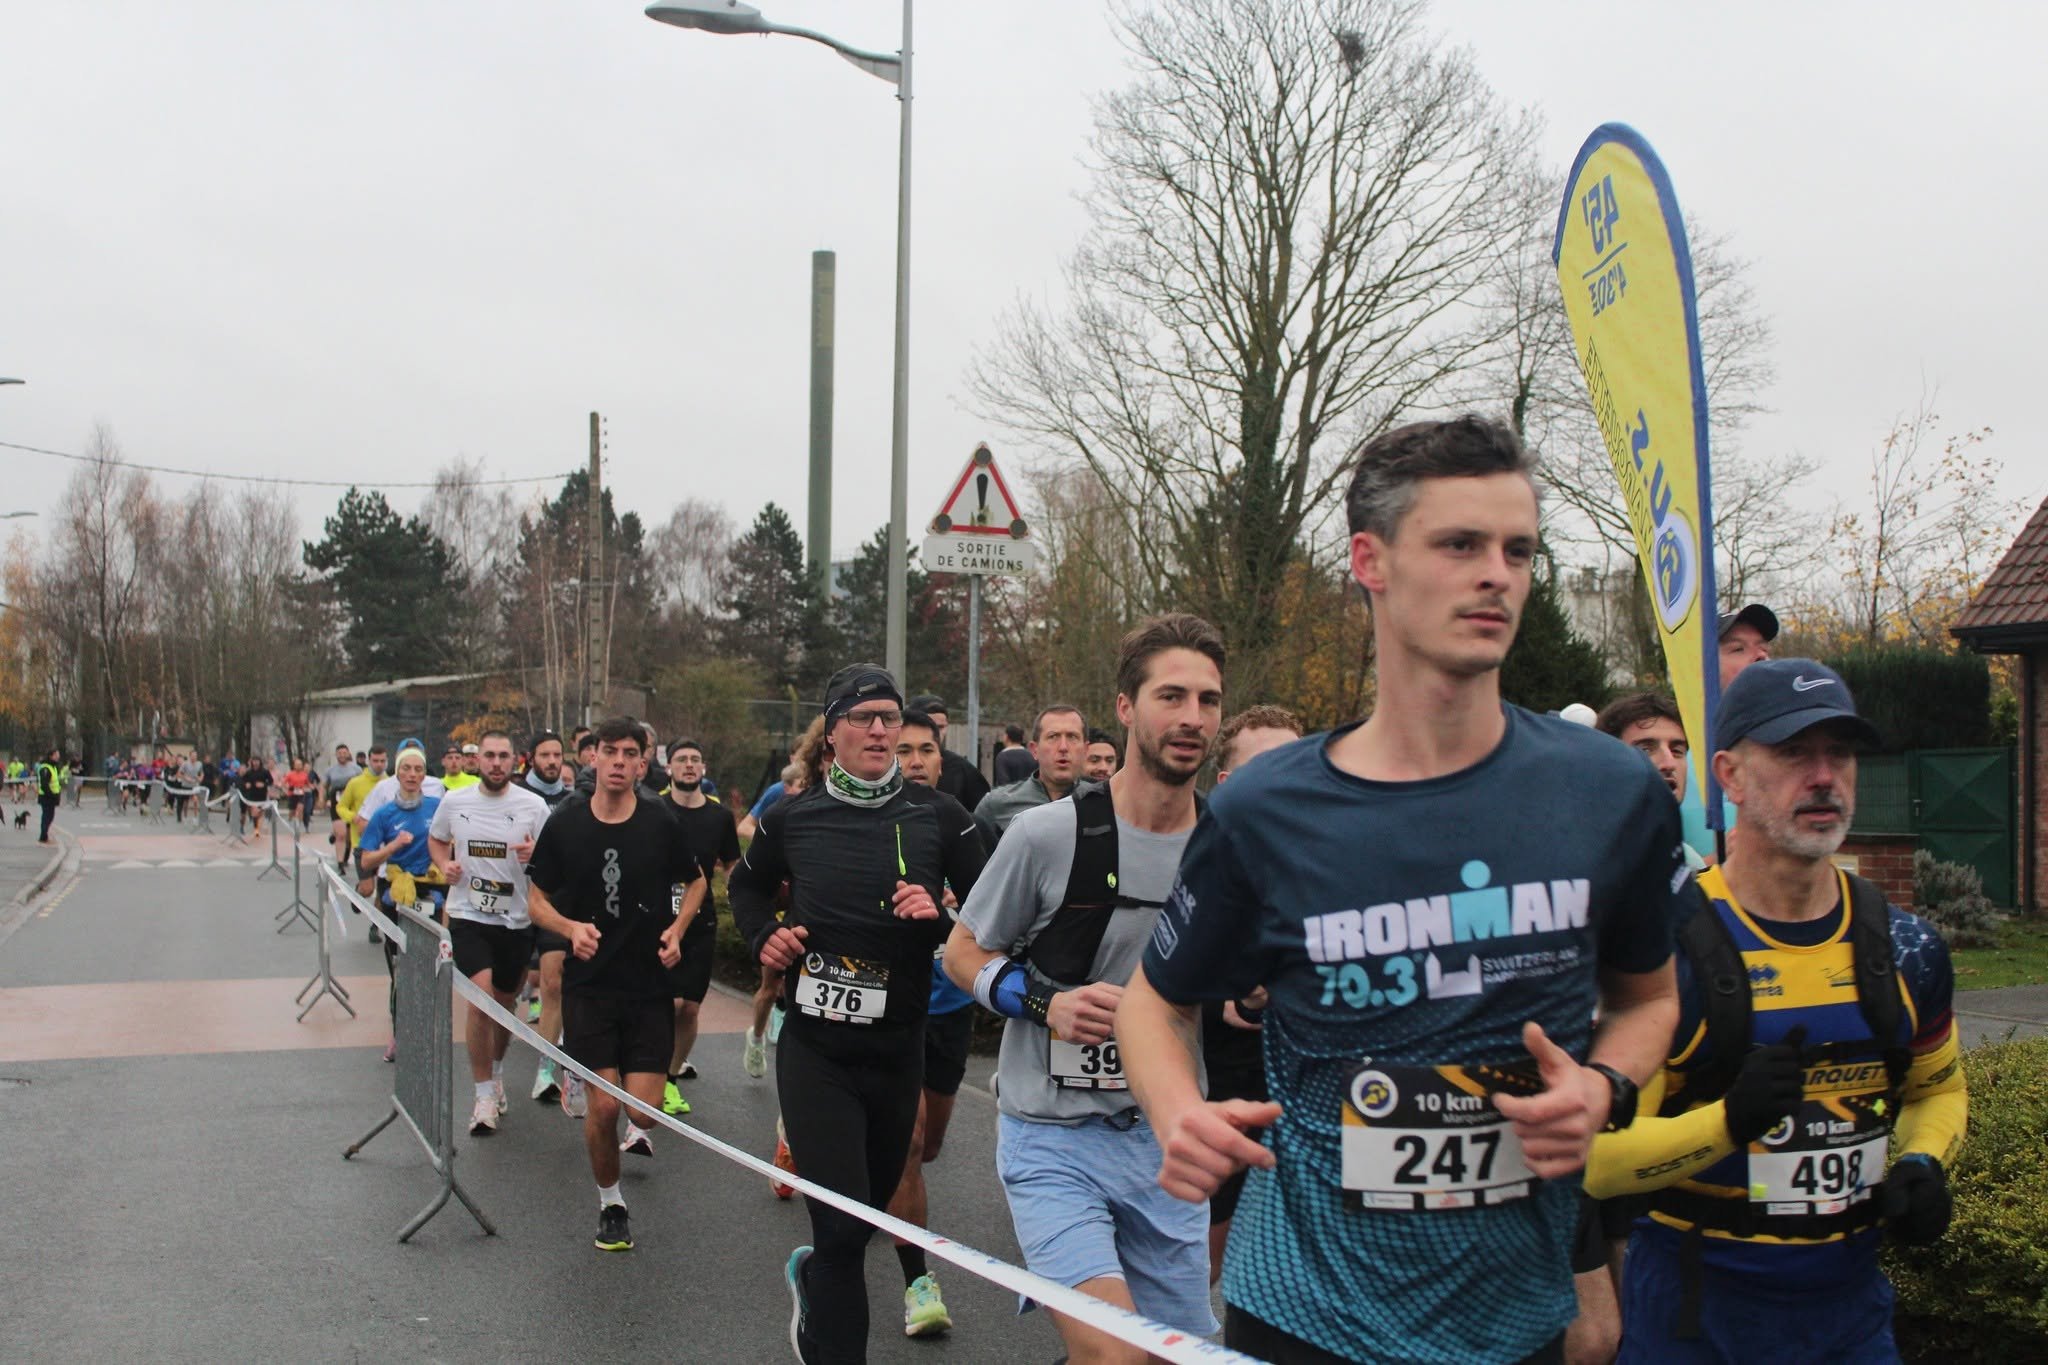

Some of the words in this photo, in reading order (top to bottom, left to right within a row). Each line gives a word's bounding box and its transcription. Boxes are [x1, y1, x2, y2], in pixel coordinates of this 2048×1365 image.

[957, 542, 1006, 556] SORTIE
[937, 555, 954, 567] DE
[961, 556, 1024, 571] CAMIONS
[480, 894, 498, 907] 37
[1303, 860, 1591, 963] IRONMAN
[828, 965, 839, 975] 10
[840, 967, 856, 979] km
[1315, 955, 1420, 1009] 70.3
[814, 982, 863, 1013] 376
[1080, 1044, 1122, 1075] 39
[1413, 1093, 1442, 1113] 10
[1446, 1091, 1483, 1111] km
[1805, 1121, 1827, 1137] 10
[1828, 1119, 1855, 1135] km
[1393, 1130, 1502, 1185] 247
[1791, 1148, 1864, 1196] 498
